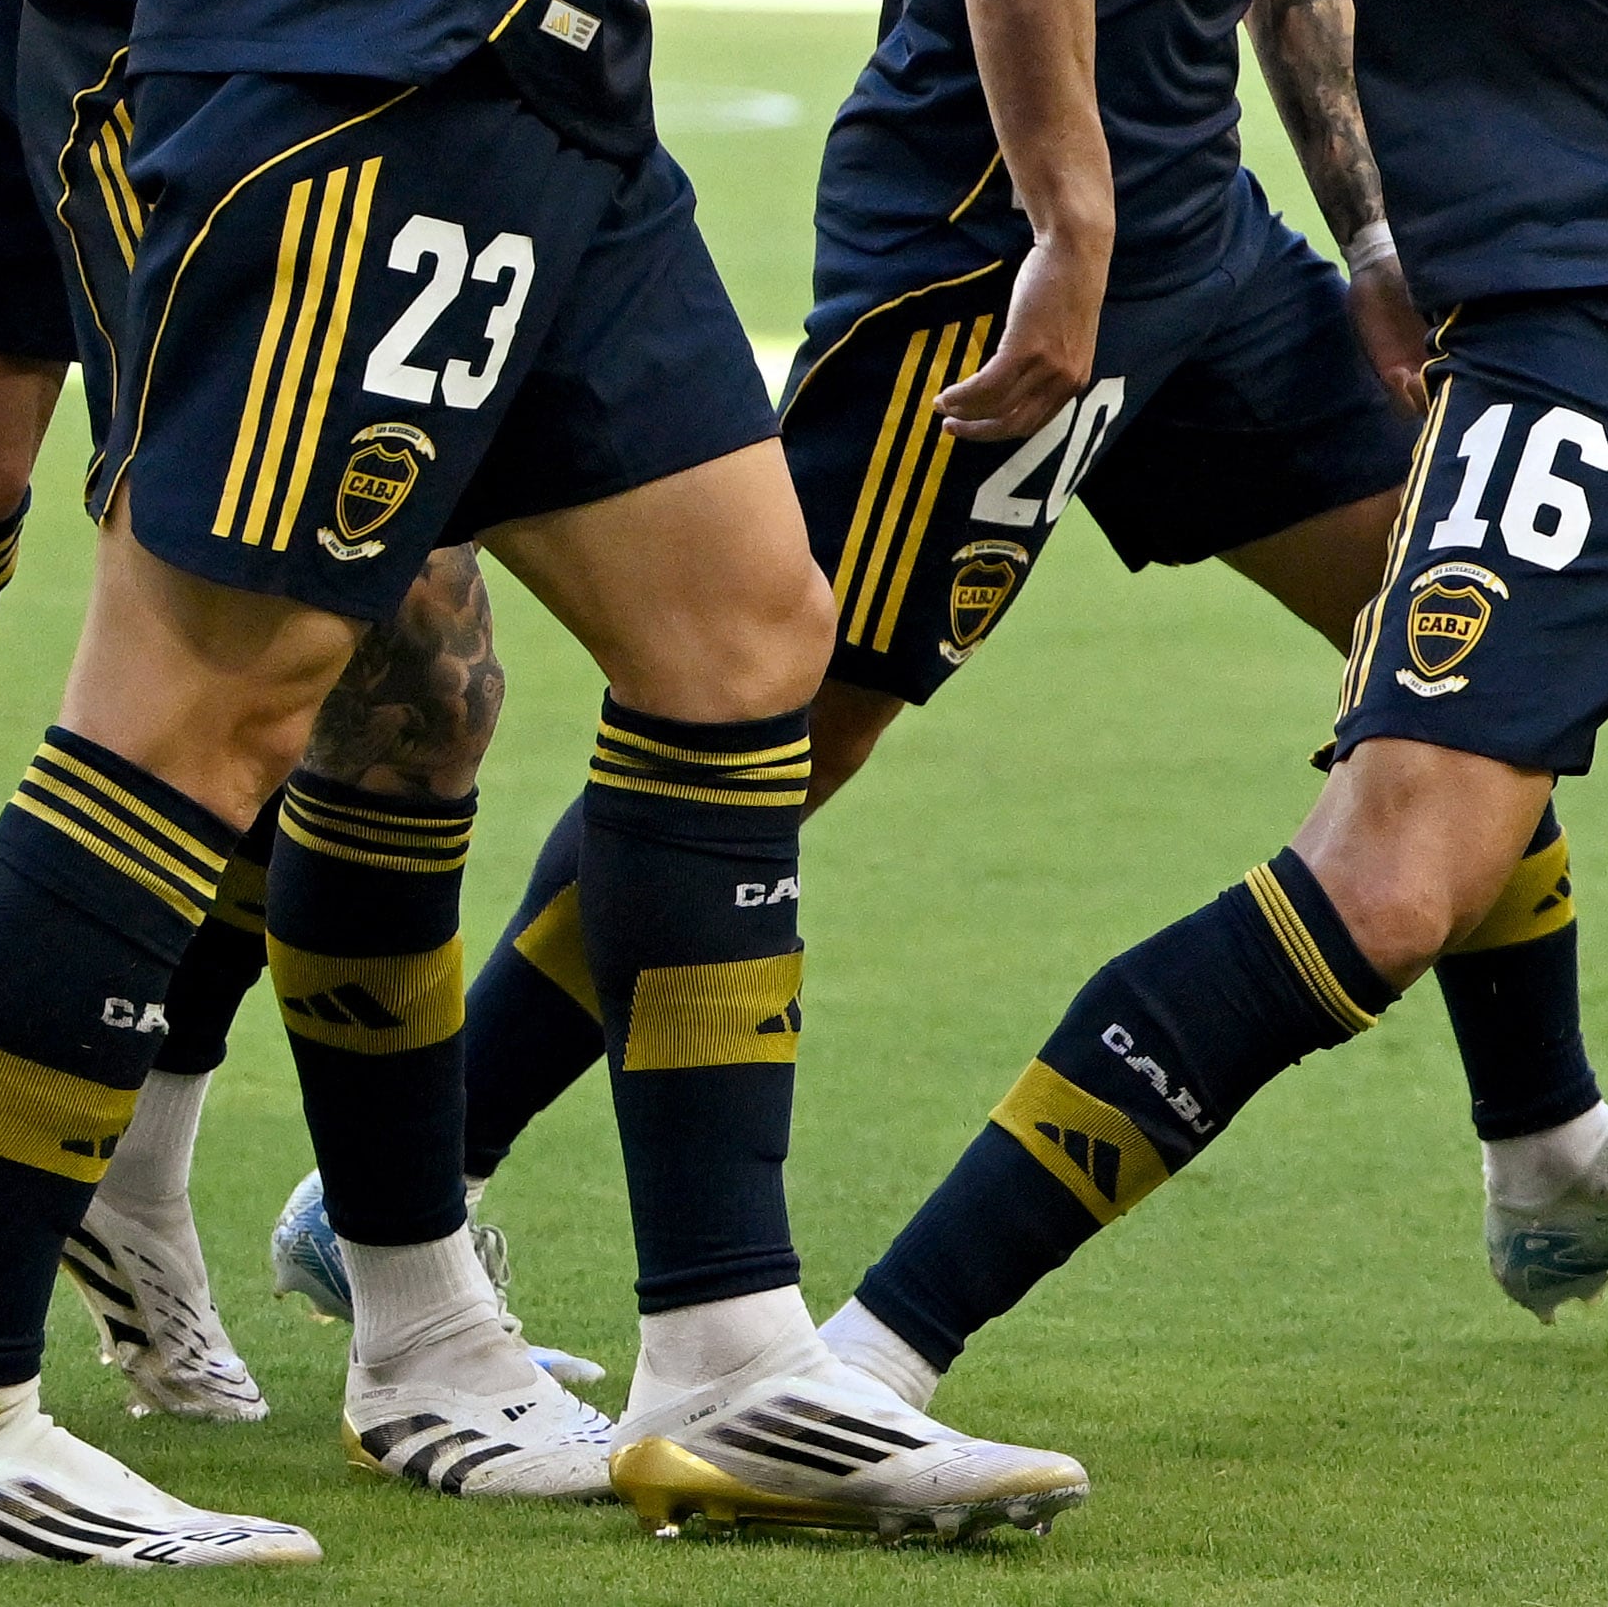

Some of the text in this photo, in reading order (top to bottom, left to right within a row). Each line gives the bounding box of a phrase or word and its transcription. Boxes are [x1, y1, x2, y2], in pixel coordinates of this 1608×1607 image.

[362, 214, 536, 409] 23
[969, 376, 1126, 527] 20
[348, 475, 399, 501] CABJ
[1418, 615, 1472, 637] CABJ
[734, 876, 801, 908] CA
[100, 997, 170, 1035] CA
[1101, 1022, 1215, 1135] CABJ
